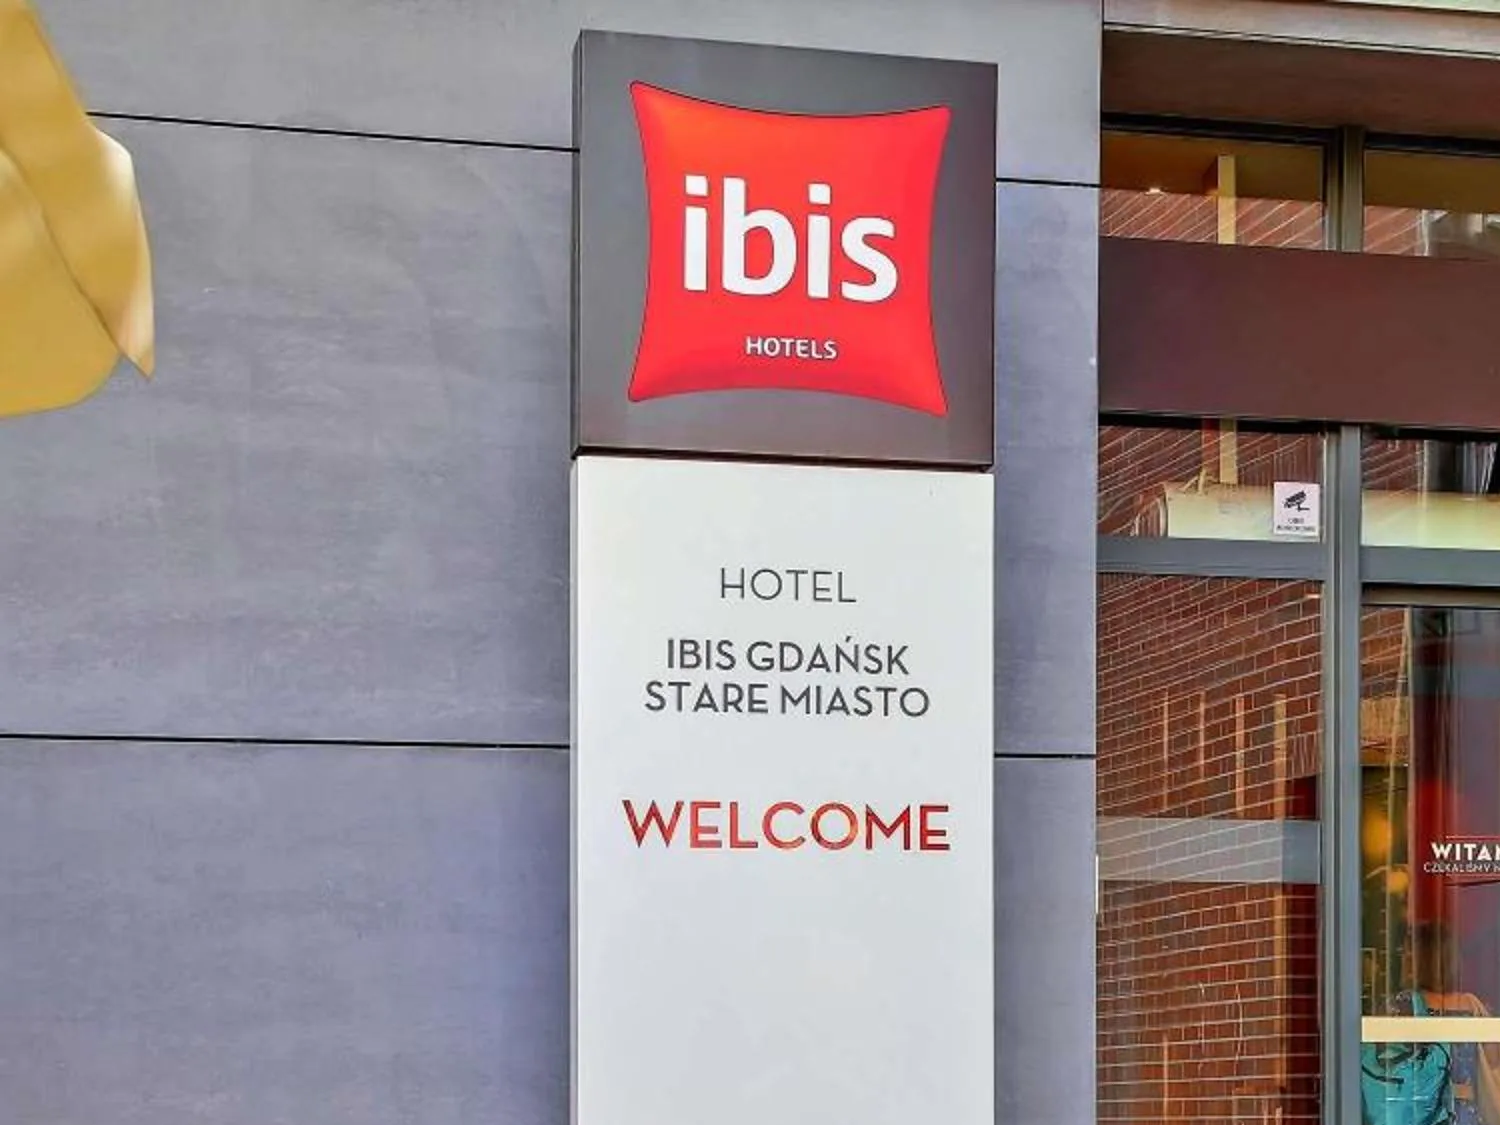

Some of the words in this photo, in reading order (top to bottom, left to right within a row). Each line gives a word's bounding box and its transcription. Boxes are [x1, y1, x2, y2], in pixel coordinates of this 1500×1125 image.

[683, 174, 899, 304] ibis
[745, 335, 838, 360] HOTELS
[719, 567, 857, 604] HOTEL
[666, 637, 737, 671] IBIS
[746, 635, 910, 676] GDAŃSK
[644, 680, 769, 715] STARE
[780, 684, 931, 718] MIASTO
[621, 799, 951, 851] WELCOME
